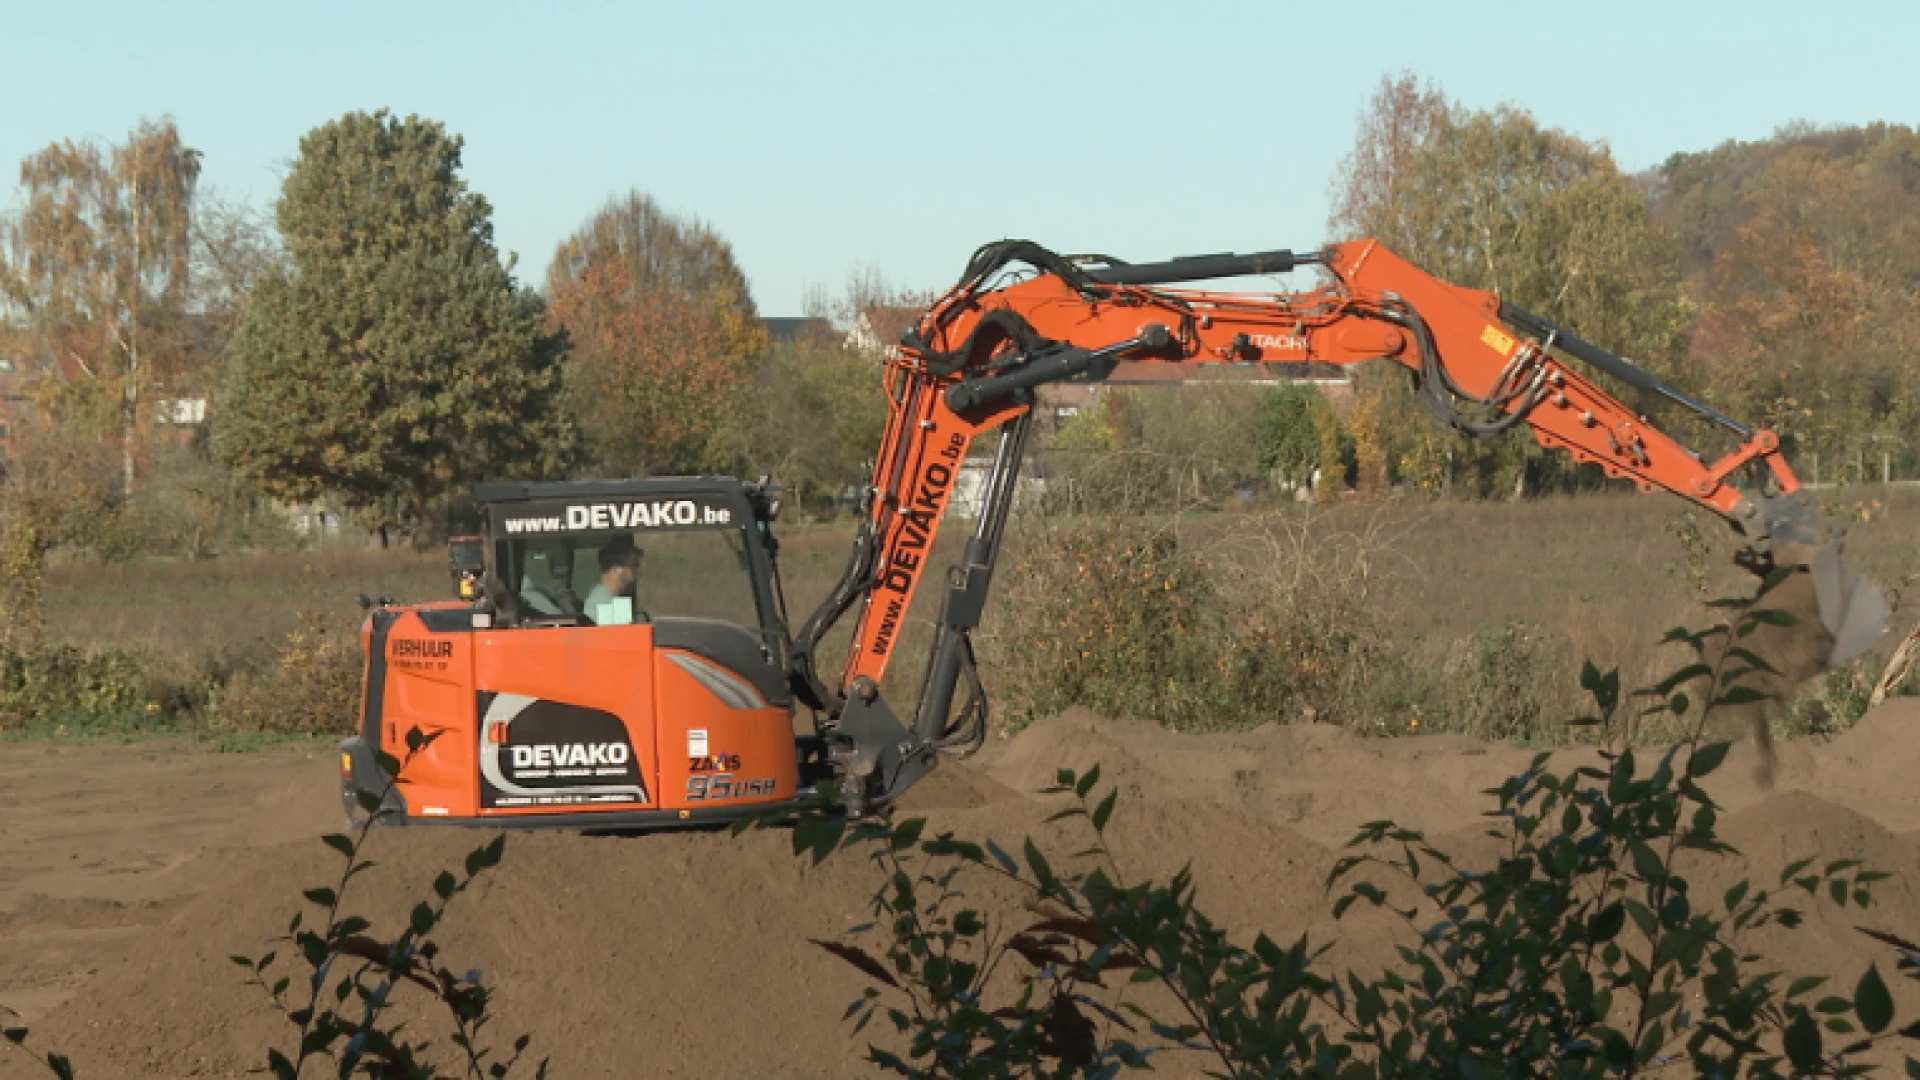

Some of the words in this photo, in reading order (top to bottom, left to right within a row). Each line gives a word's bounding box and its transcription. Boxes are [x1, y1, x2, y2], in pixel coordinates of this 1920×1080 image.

[505, 500, 731, 534] www.DEVAKO.be
[872, 432, 966, 656] www.DEVAKO.be
[511, 741, 629, 769] DEVAKO
